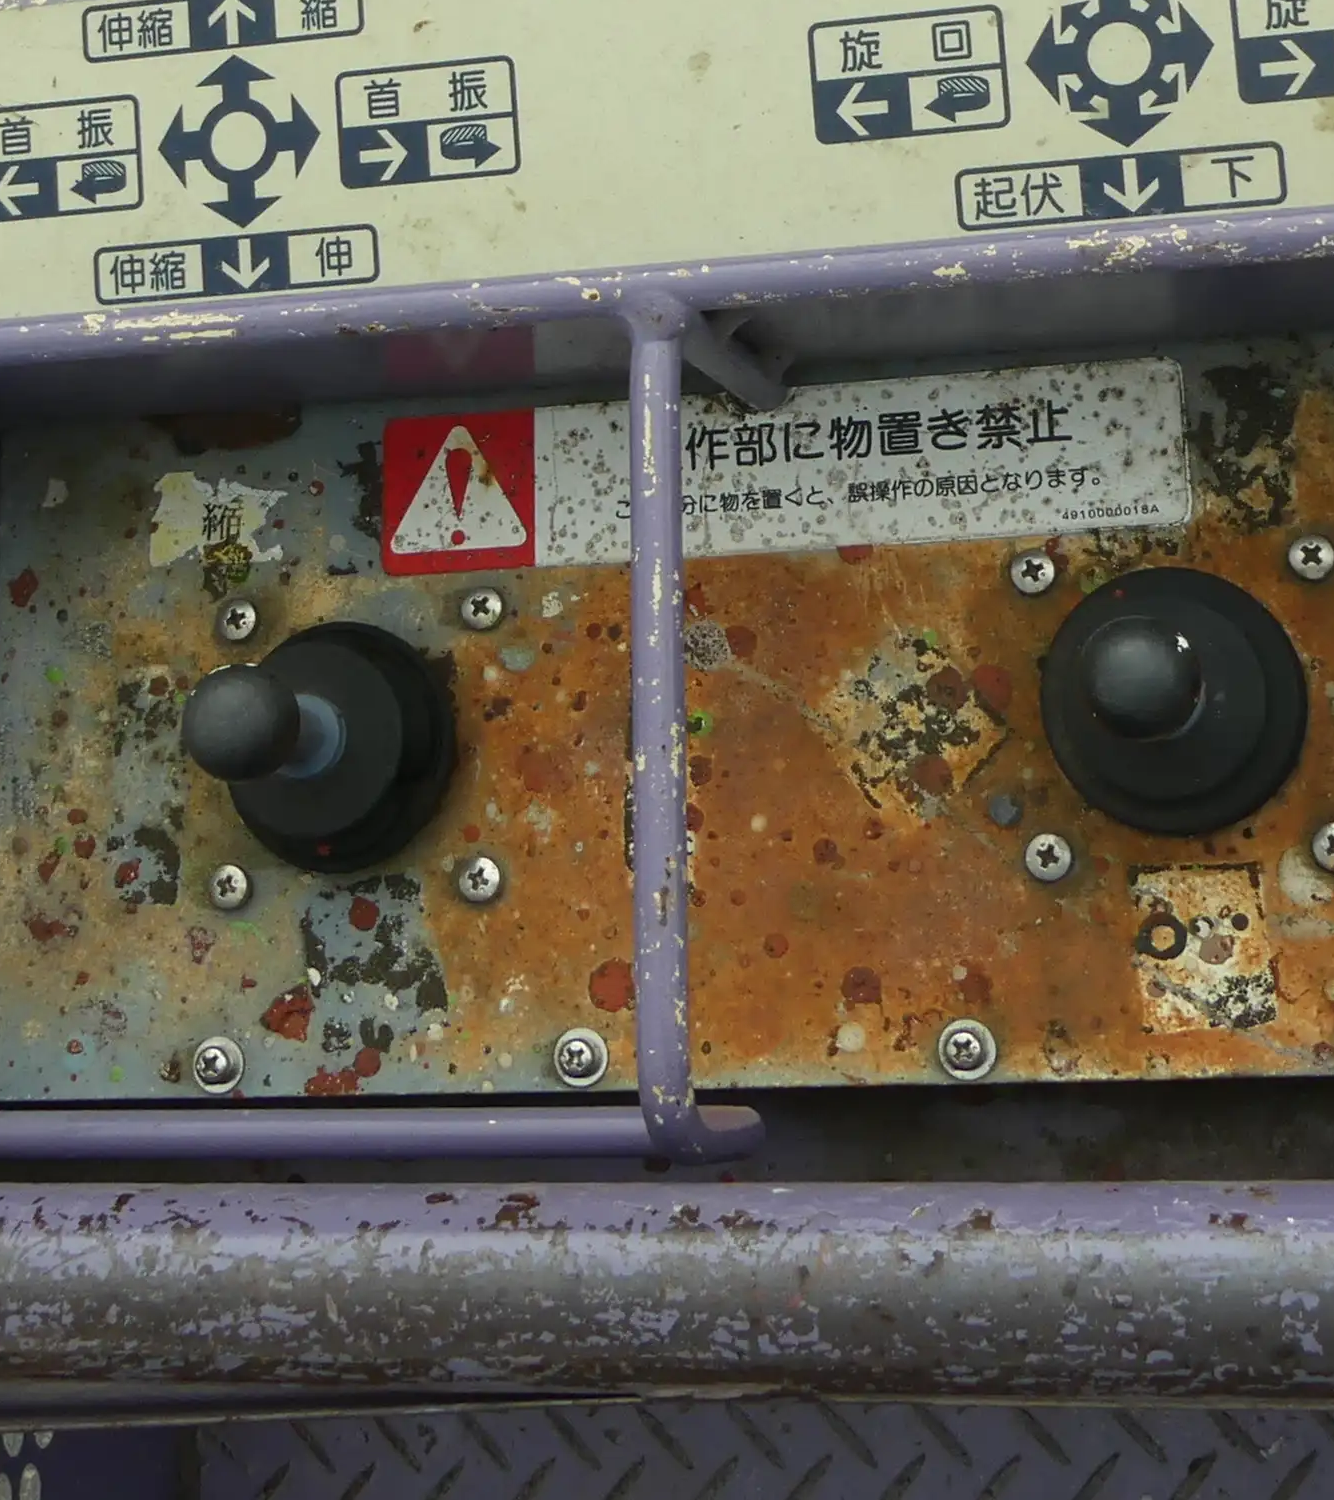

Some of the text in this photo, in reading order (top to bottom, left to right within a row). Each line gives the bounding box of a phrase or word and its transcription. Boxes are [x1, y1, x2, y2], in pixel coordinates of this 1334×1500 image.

[98, 8, 174, 53] 伸縮
[974, 156, 1255, 220] 起伏 下
[110, 236, 352, 294] 伸縮 伸
[685, 400, 1073, 470] 作部に物置き禁止
[616, 467, 1101, 519] こ分に物を置くと、誤操作の原因となります。
